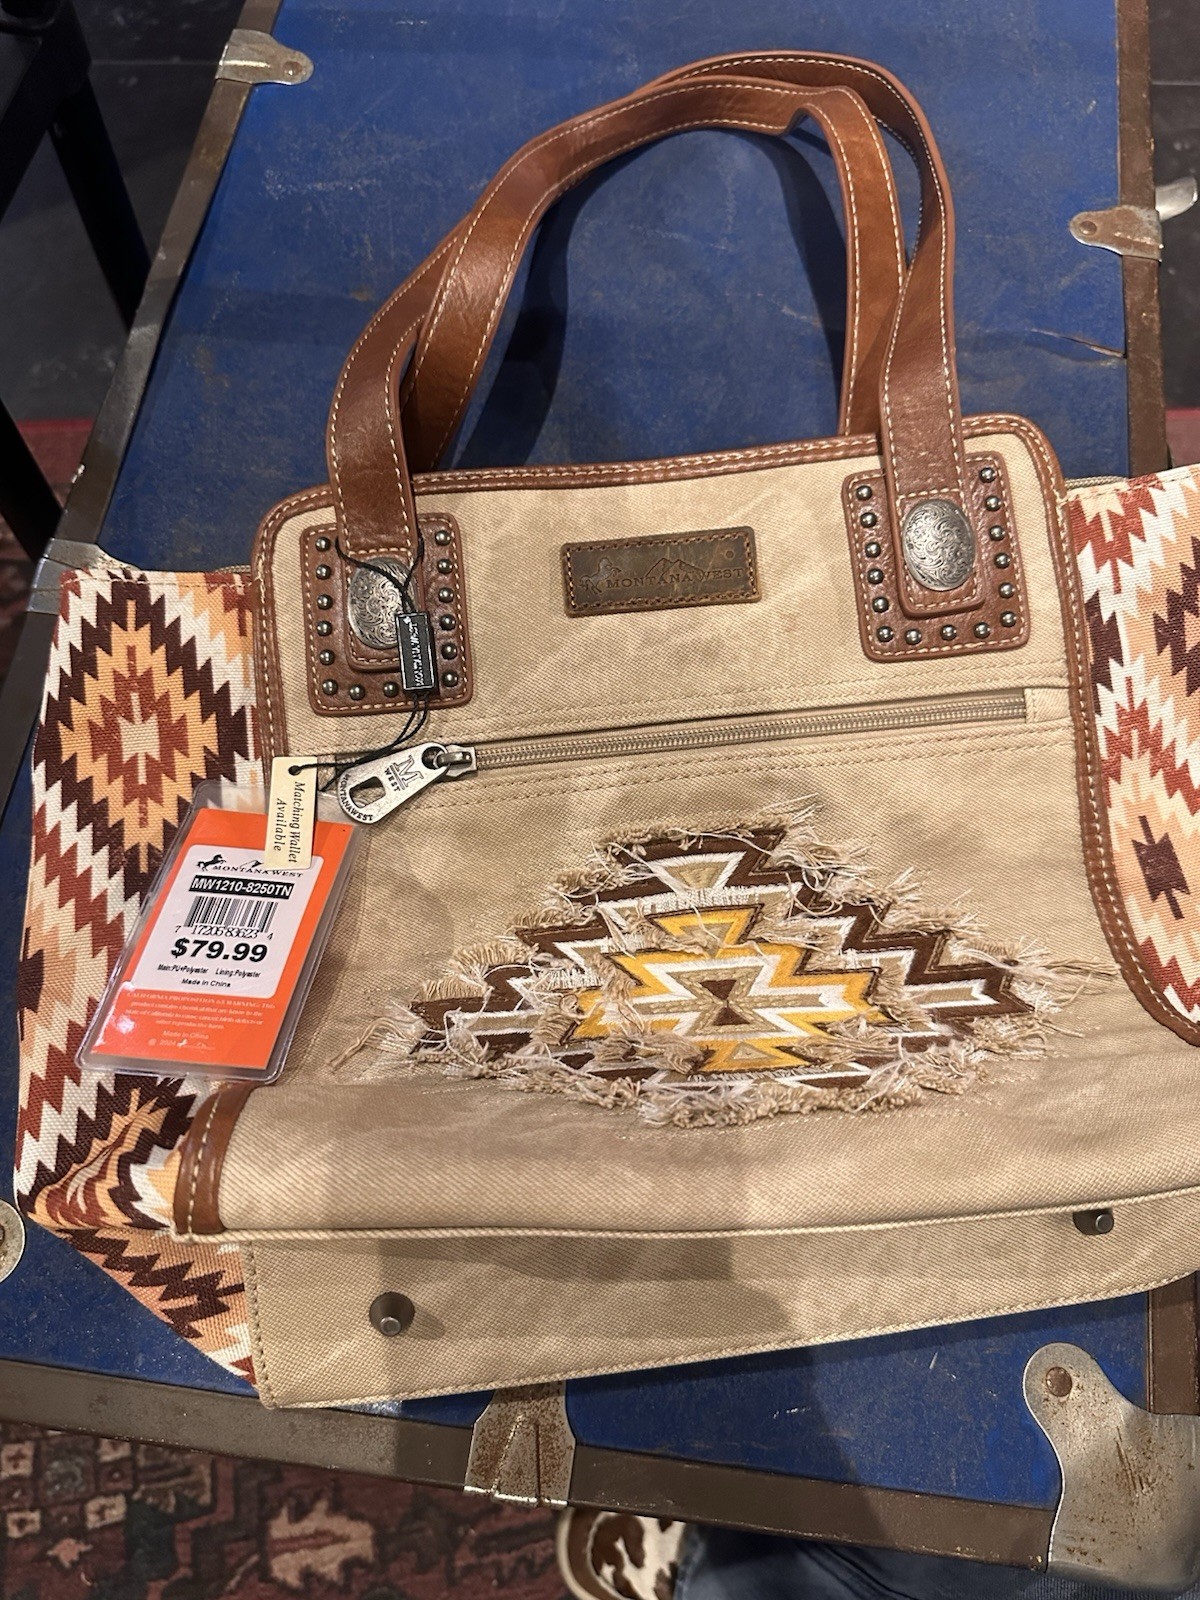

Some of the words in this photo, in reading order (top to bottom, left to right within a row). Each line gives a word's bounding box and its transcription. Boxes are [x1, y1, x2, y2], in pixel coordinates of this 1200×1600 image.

[605, 572, 693, 589] MONTANA
[699, 568, 744, 582] WEST
[384, 767, 401, 792] WEST
[289, 781, 306, 829] Matching
[274, 797, 288, 852] Available
[288, 831, 301, 863] Wallet
[212, 865, 269, 875] MONTANA
[272, 869, 304, 878] WEST
[191, 877, 293, 897] MW1210-8250TN
[175, 925, 182, 933] 7
[267, 932, 274, 940] 4
[170, 937, 268, 963] $79.99
